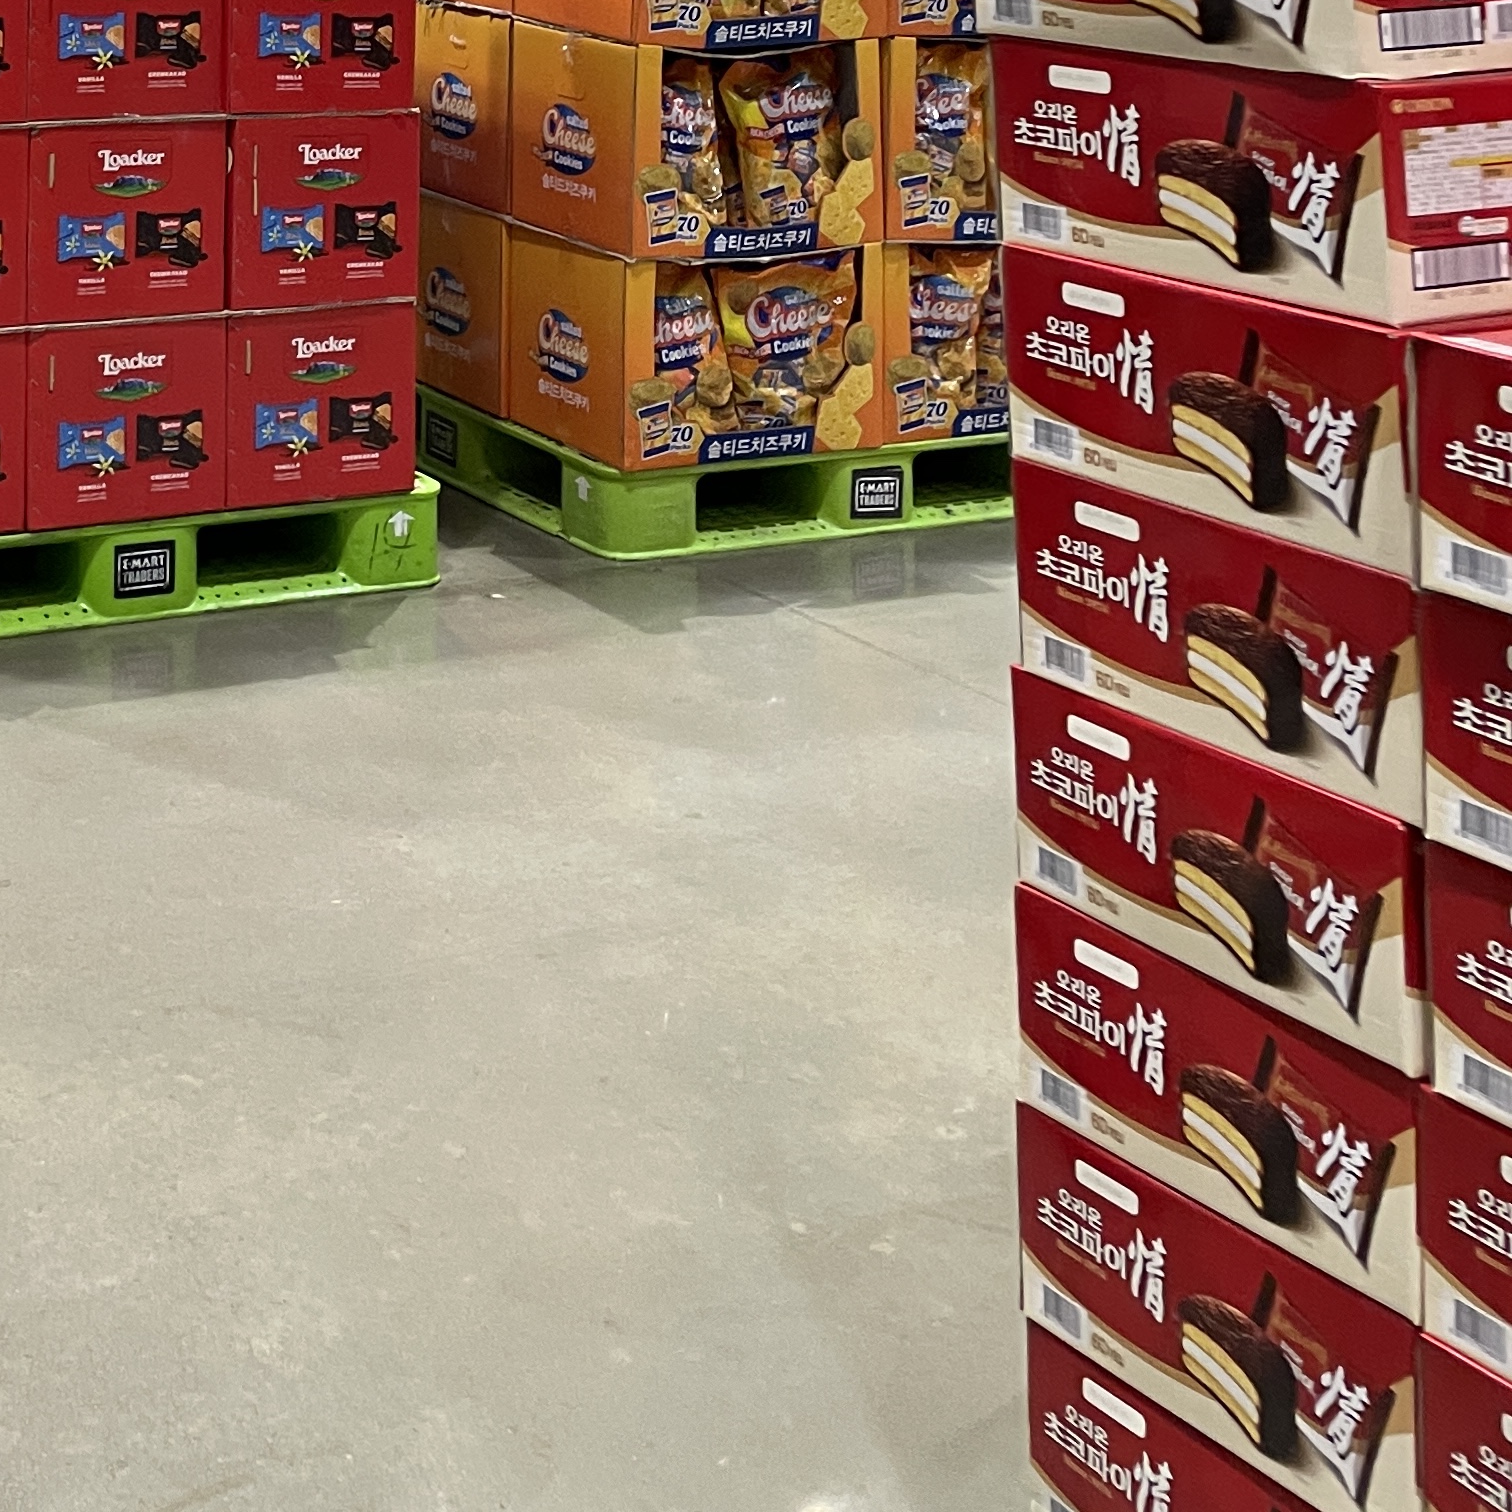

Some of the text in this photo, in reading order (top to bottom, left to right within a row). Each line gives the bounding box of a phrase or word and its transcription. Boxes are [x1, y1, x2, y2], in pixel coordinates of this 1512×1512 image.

[677, 5, 701, 22] 70
[715, 19, 812, 43] 솔티드치즈쿠키
[1033, 100, 1078, 125] 오리온
[1014, 117, 1103, 161] 초코파이
[97, 148, 165, 172] Loacker
[298, 143, 363, 167] Loacker
[930, 200, 950, 216] 70
[677, 216, 699, 233] 70
[713, 228, 811, 253] 솔티드치즈쿠키
[746, 296, 834, 338] Cheese
[1045, 316, 1092, 345] 오리온
[292, 335, 356, 359] Loacker
[1026, 331, 1115, 384] 초코파이
[98, 351, 166, 376] Loacker
[926, 401, 948, 417] 70
[670, 425, 693, 442] 70
[708, 433, 807, 459] 솔티드치즈쿠키
[1057, 534, 1105, 567] 오리온
[122, 567, 165, 585] TRADERS
[1036, 548, 1130, 609] 초코파이
[1051, 746, 1095, 783] 오리온
[1030, 759, 1119, 827] 초코파이
[1056, 969, 1102, 1009] 오리온
[1033, 980, 1126, 1056] 초코파이
[1058, 1188, 1103, 1232] 오리온
[1037, 1197, 1127, 1280] 초코파이
[1064, 1404, 1109, 1451] 오리온
[1044, 1411, 1133, 1502] 초코파이
